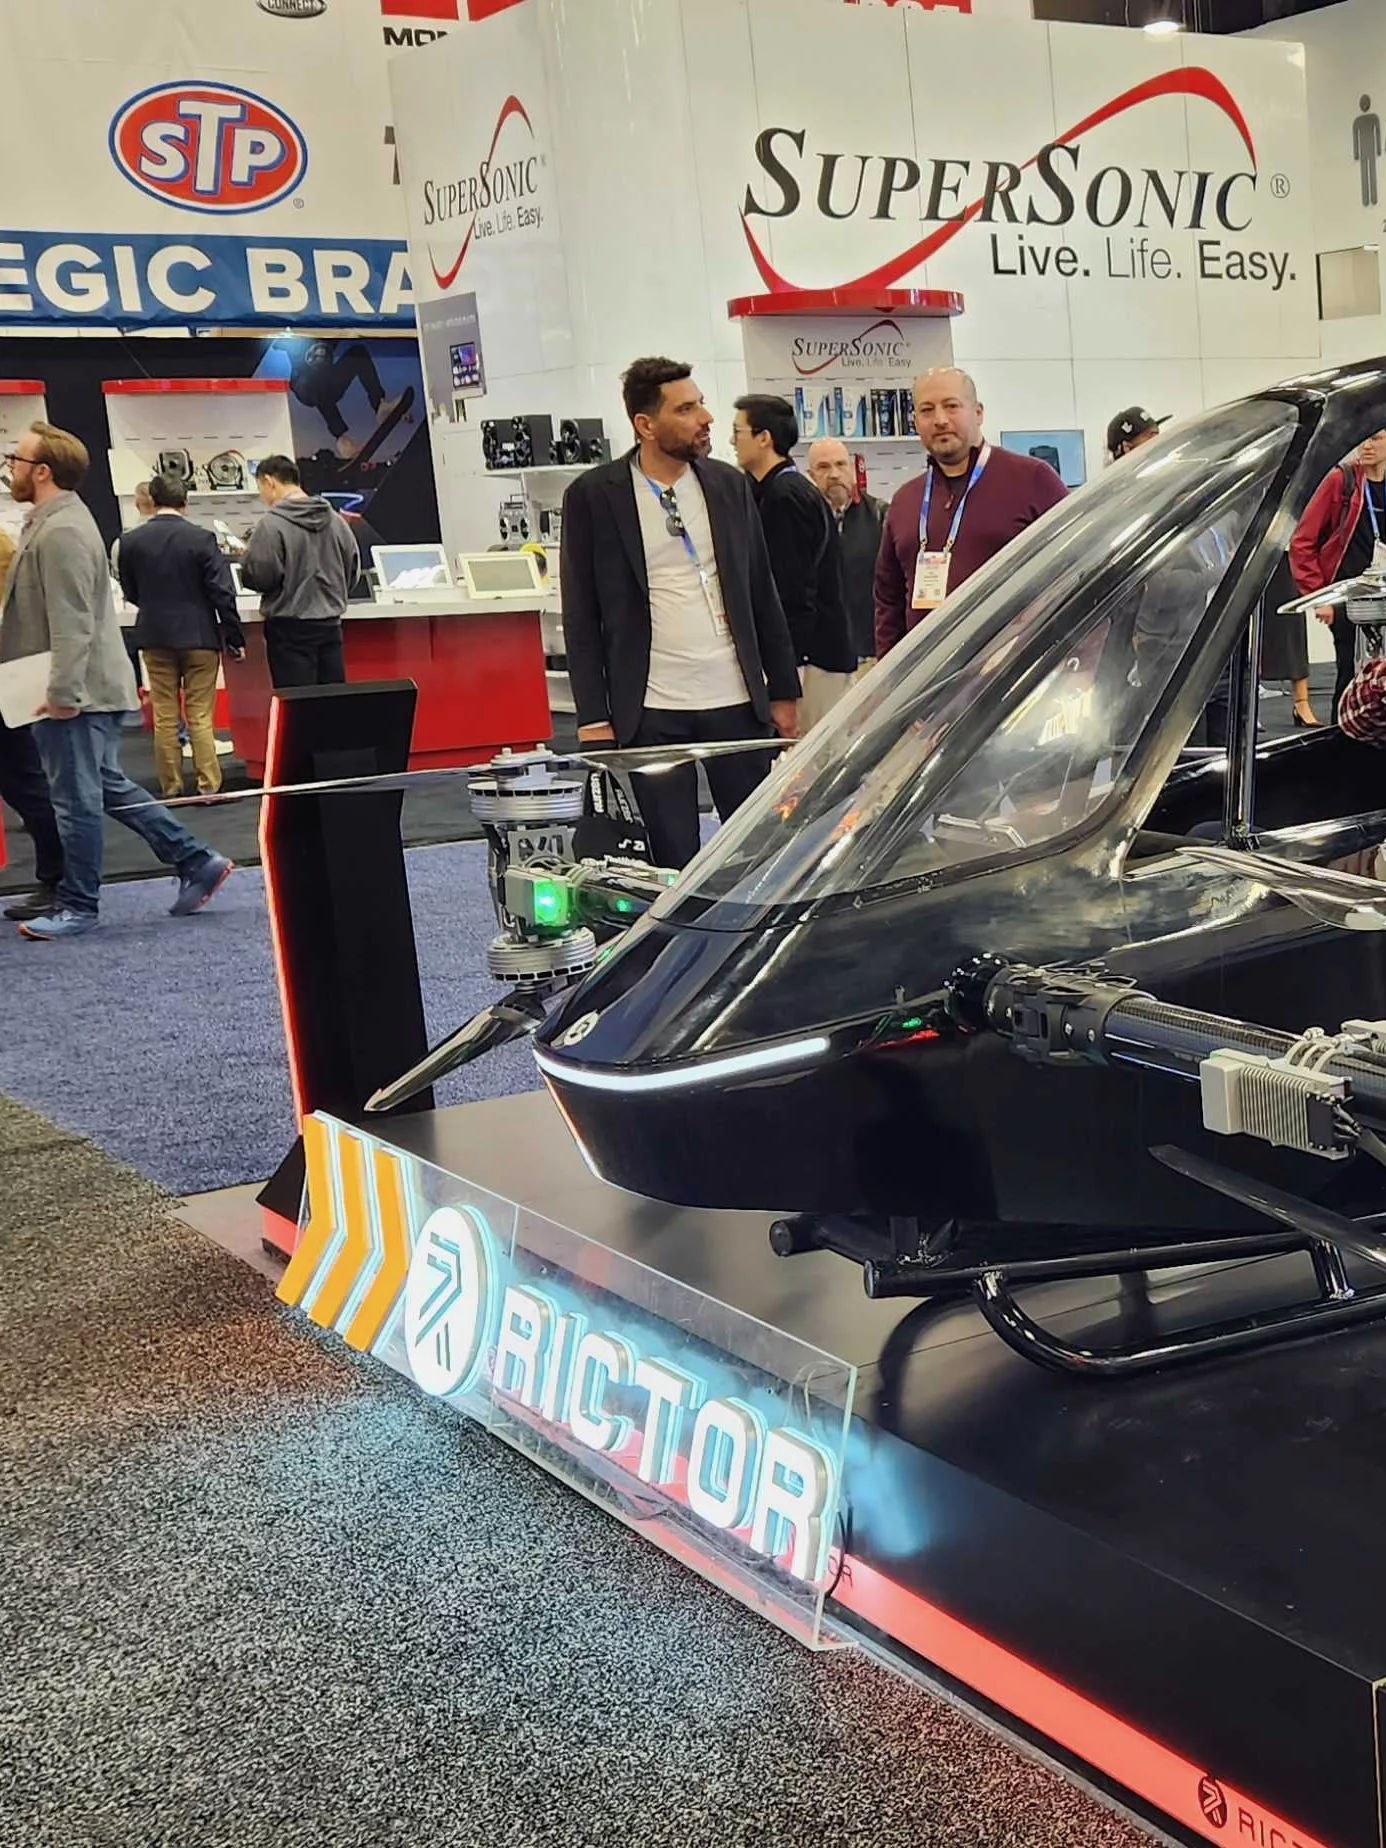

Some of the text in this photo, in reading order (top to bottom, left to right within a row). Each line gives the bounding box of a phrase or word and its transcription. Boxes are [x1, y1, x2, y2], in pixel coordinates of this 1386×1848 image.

[139, 99, 288, 195] STP
[991, 233, 1297, 292] Live. Life. Easy.
[493, 1286, 837, 1583] RICTOR
